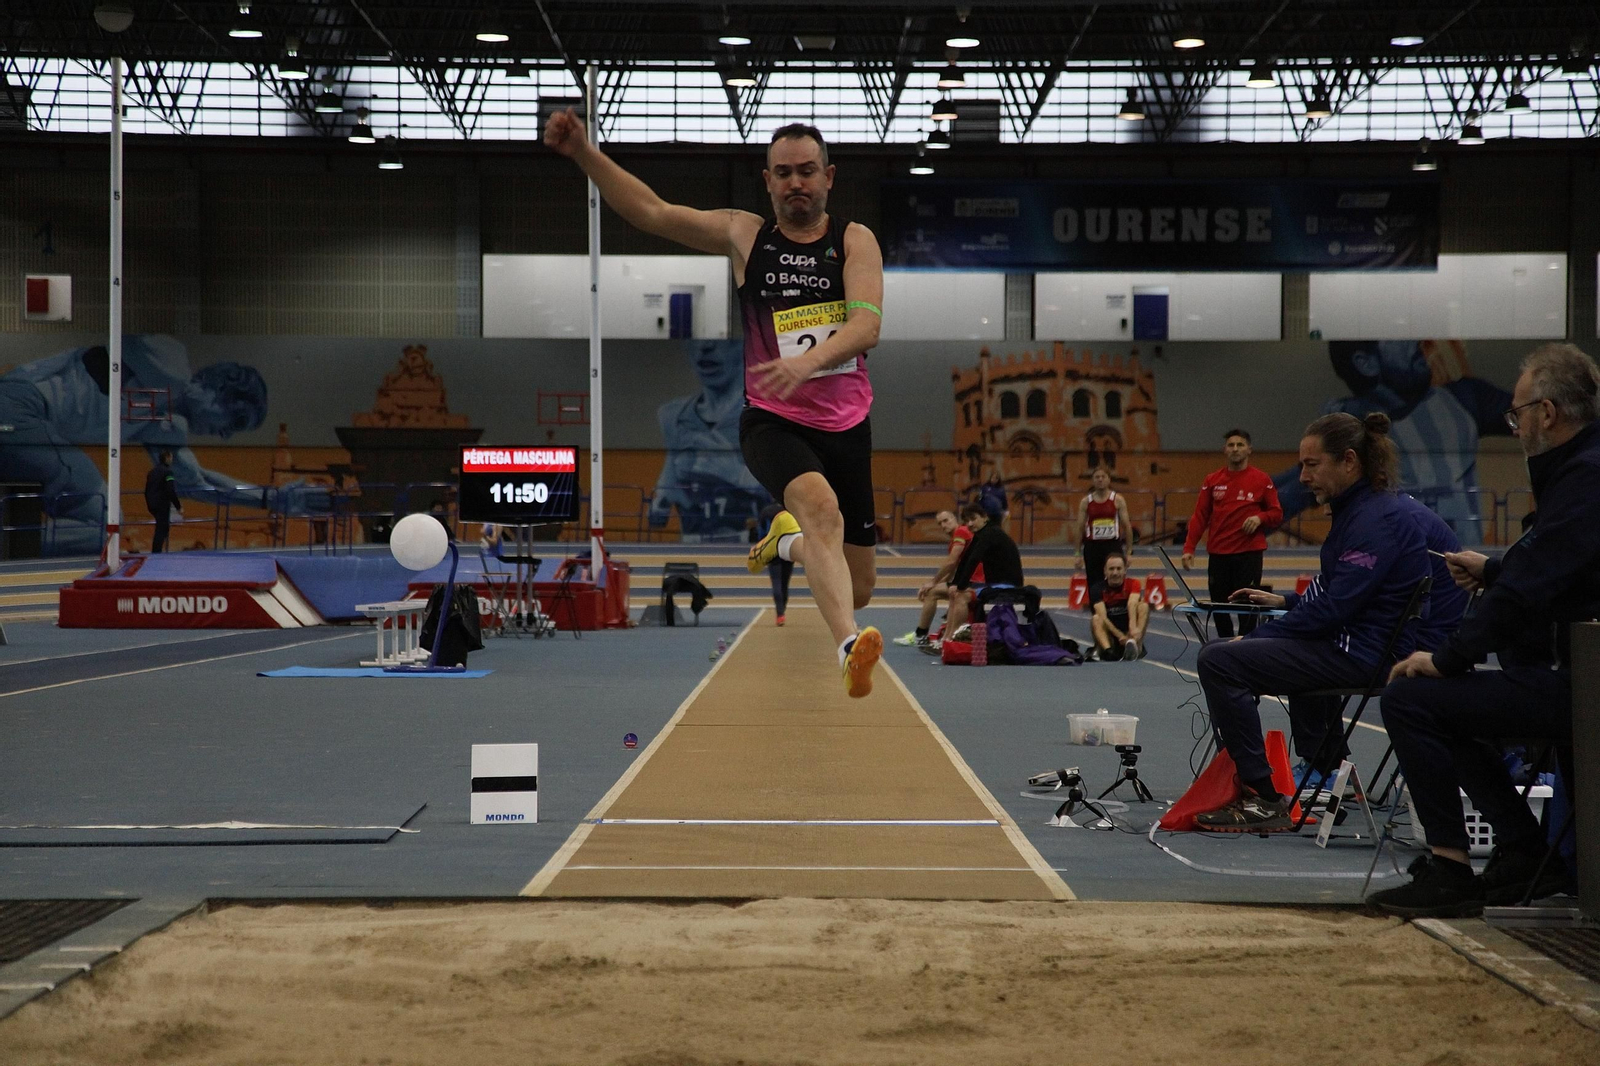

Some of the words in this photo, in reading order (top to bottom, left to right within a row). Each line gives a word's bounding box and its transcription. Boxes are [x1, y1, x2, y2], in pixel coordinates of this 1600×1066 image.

[114, 191, 120, 201] 5
[591, 199, 596, 209] 5
[1052, 206, 1272, 243] OURENSE
[113, 277, 120, 286] 4
[591, 284, 597, 293] 4
[765, 272, 776, 284] O
[779, 272, 831, 290] BARCO
[778, 312, 794, 322] XXI
[796, 304, 836, 318] MASTER
[778, 316, 824, 333] OURENSE
[112, 363, 119, 373] 3
[592, 368, 598, 378] 3
[111, 448, 117, 458] 2
[463, 448, 513, 465] PÉRTEGA
[513, 451, 575, 465] MASCULINA
[592, 453, 598, 463] 2
[489, 482, 549, 503] 11:50
[700, 497, 727, 518] 17
[1074, 586, 1086, 605] 7
[1148, 586, 1163, 605] 6
[137, 595, 228, 615] MONDO
